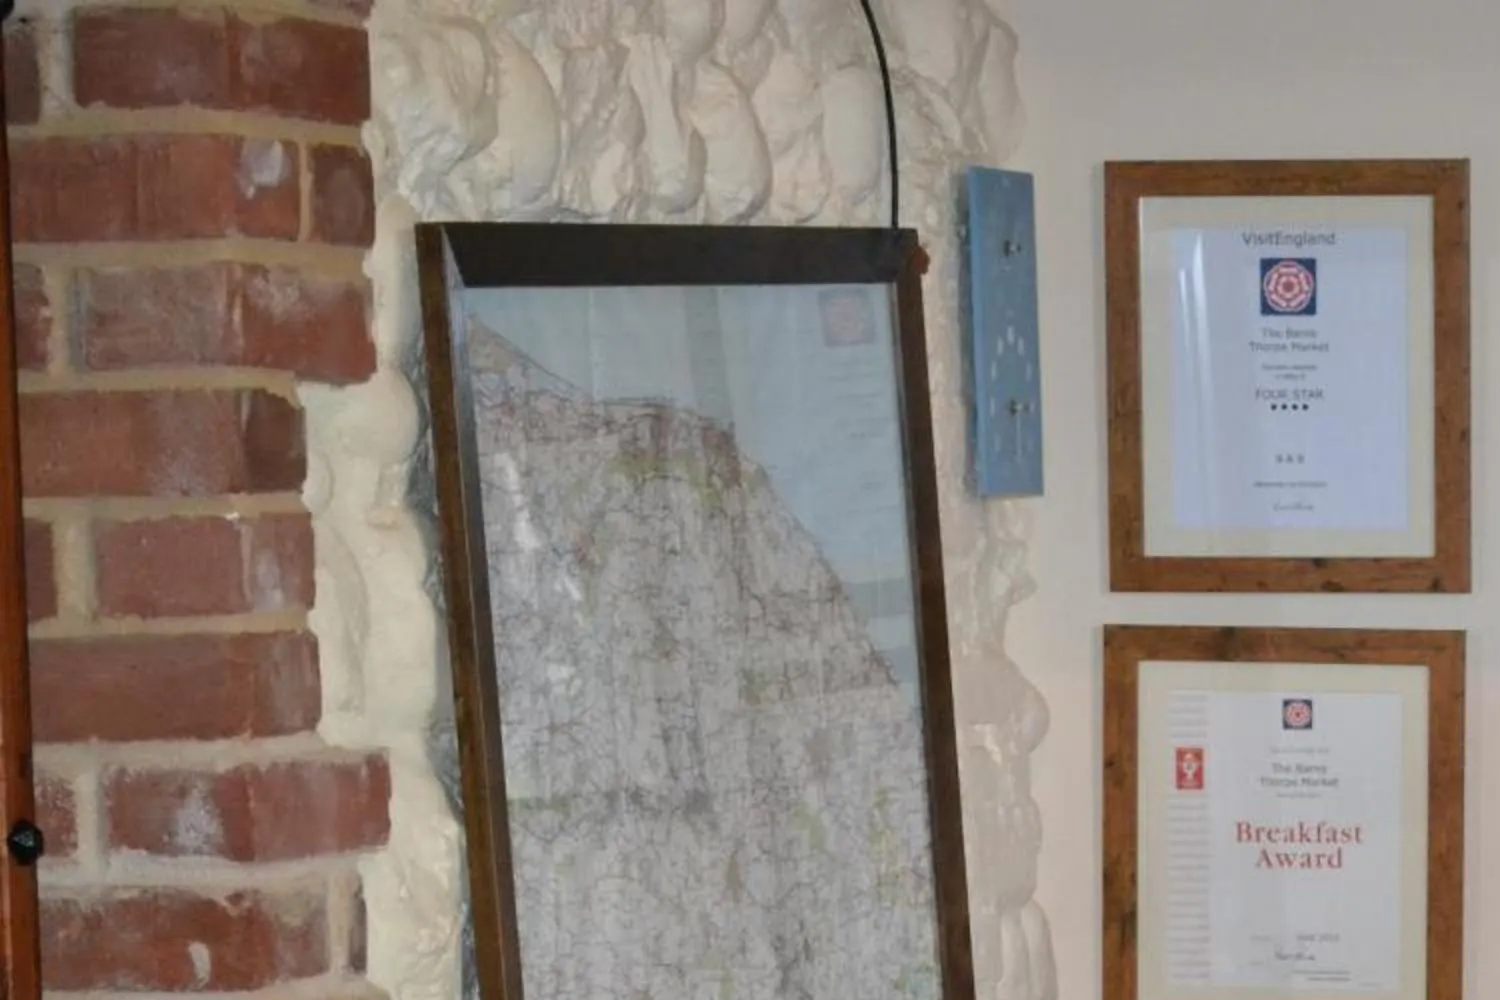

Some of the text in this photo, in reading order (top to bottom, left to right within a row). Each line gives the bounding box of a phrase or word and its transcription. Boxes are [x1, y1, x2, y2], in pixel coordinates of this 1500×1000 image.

[1241, 231, 1336, 247] VisitEngland
[1235, 821, 1363, 844] Breakfast
[1255, 848, 1343, 870] Award
